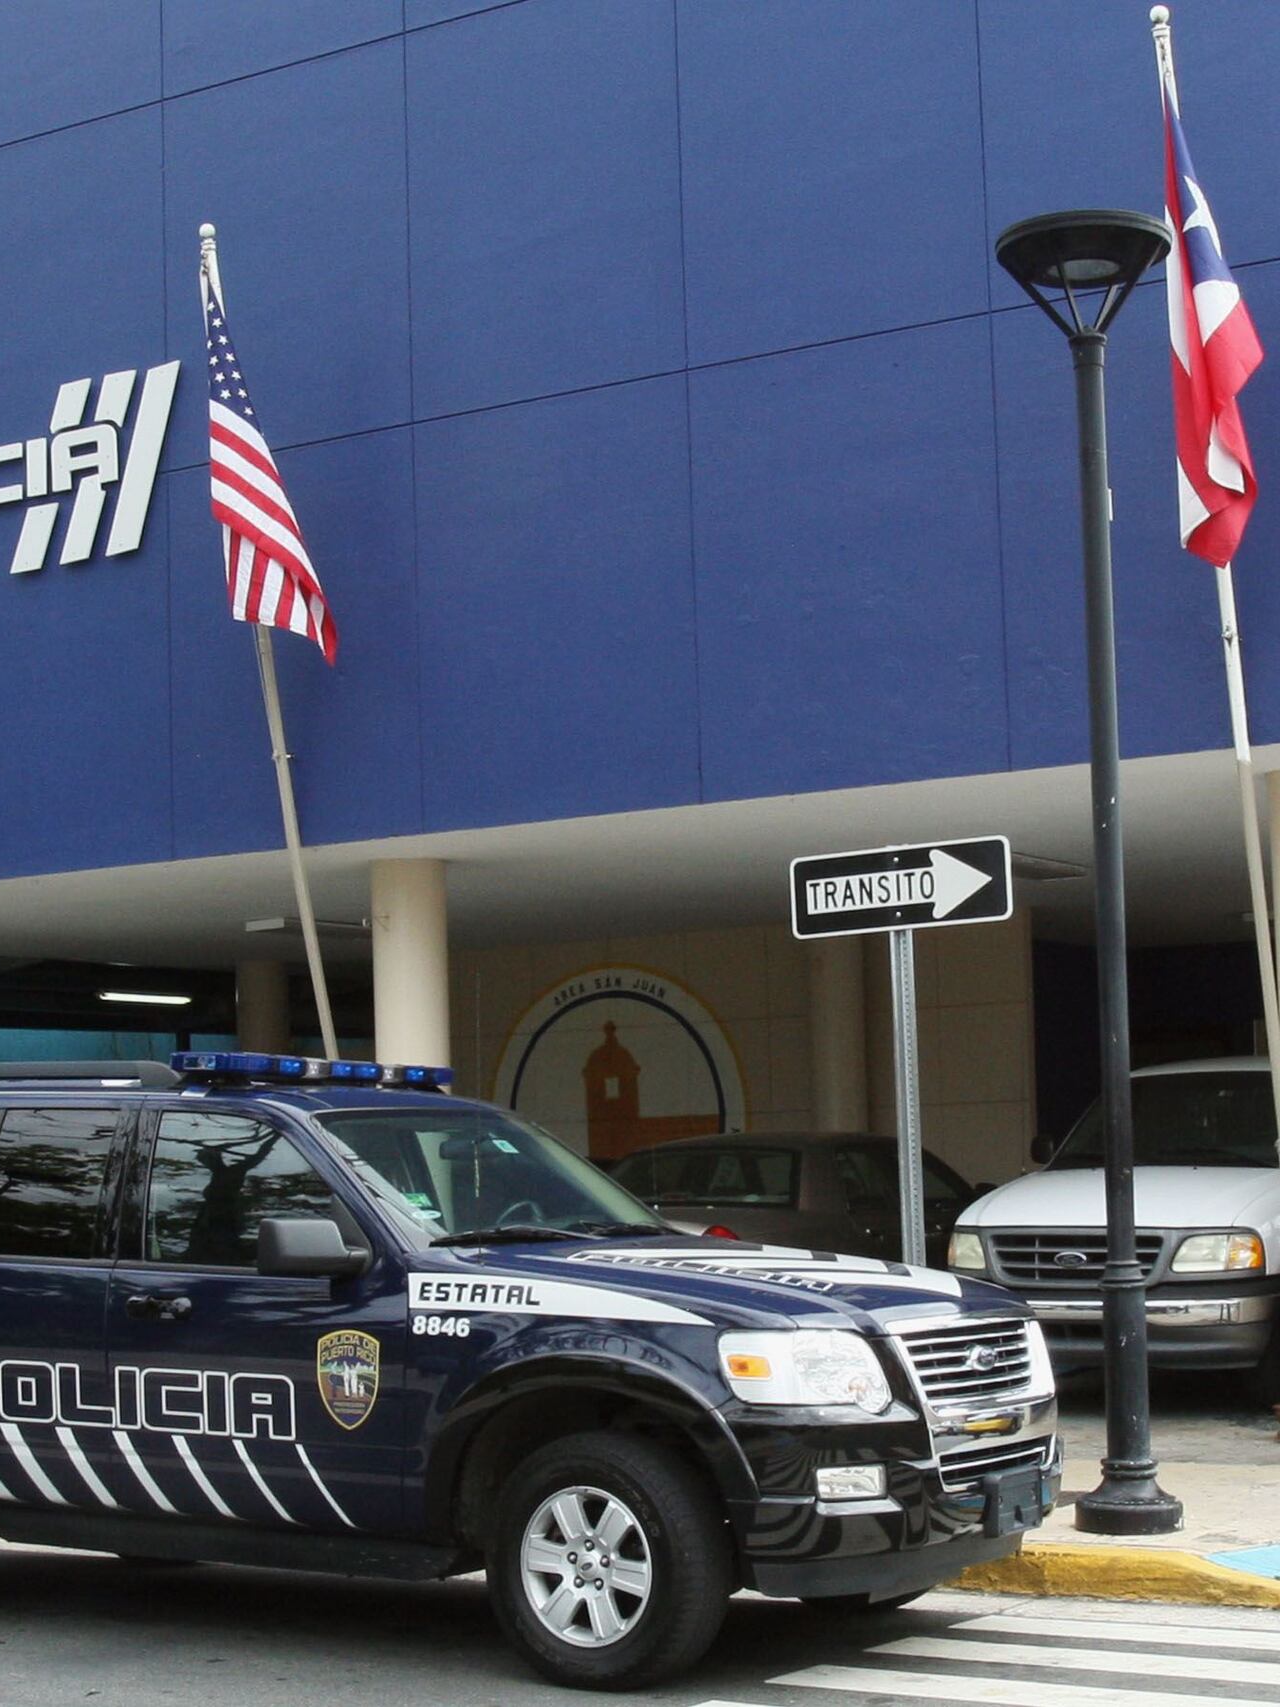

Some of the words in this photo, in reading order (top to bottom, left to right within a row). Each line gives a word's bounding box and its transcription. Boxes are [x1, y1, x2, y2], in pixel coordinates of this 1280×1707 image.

[809, 871, 934, 910] TRANSITO
[419, 1282, 540, 1306] ESTATAL
[412, 1315, 471, 1338] 8846
[321, 1335, 360, 1350] POLICIA
[362, 1338, 377, 1354] DE
[321, 1345, 355, 1364] PUERTO
[356, 1346, 376, 1365] RICO
